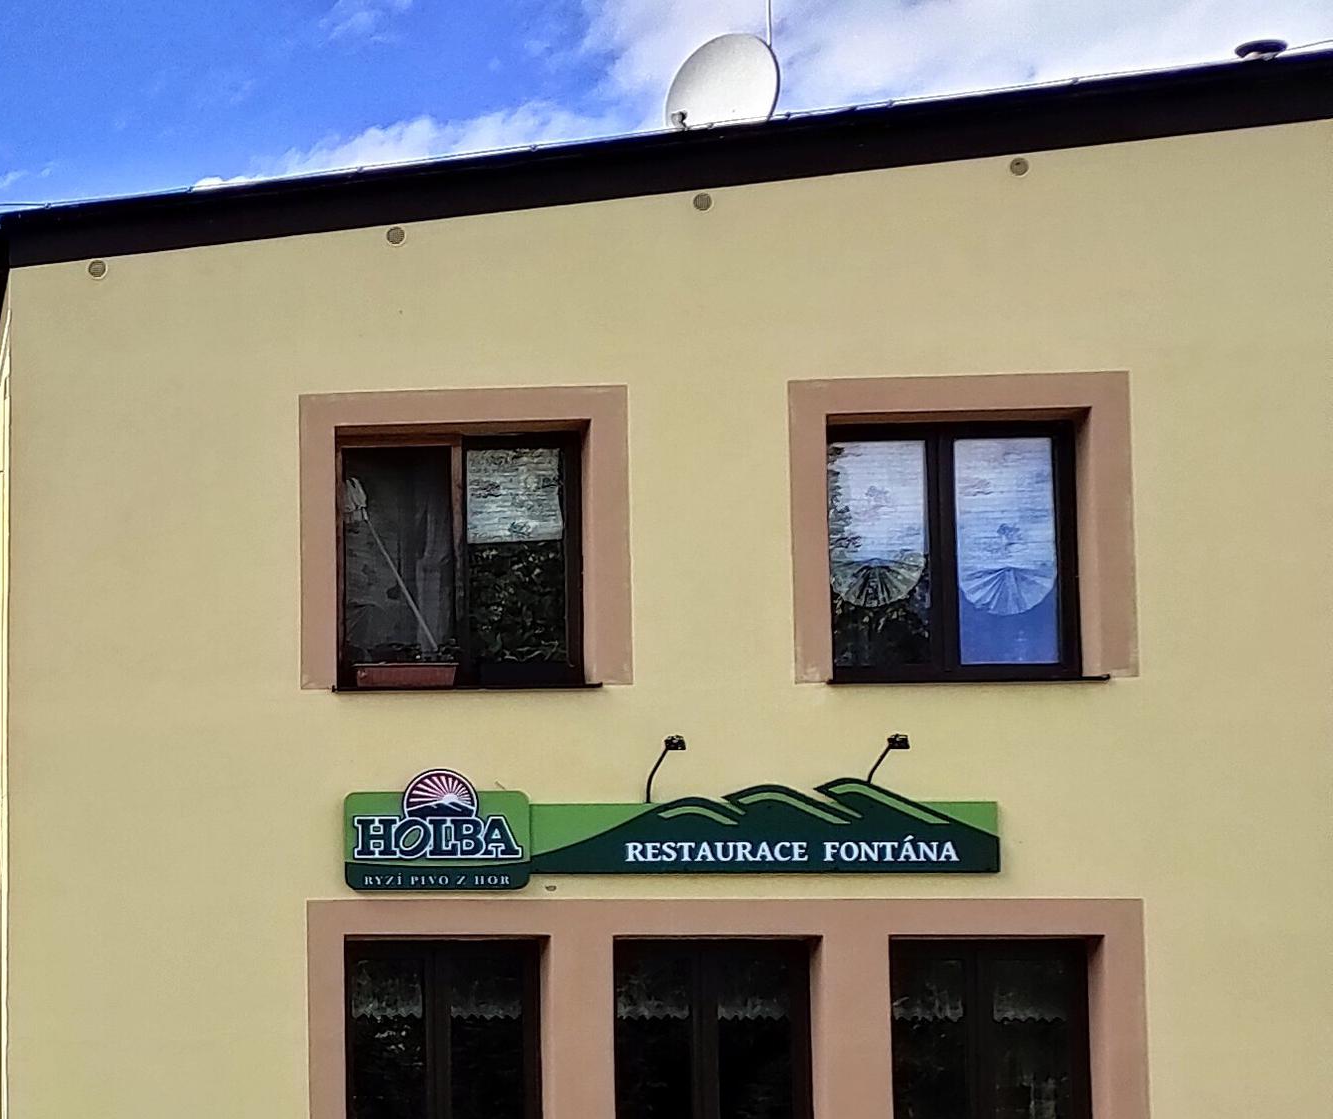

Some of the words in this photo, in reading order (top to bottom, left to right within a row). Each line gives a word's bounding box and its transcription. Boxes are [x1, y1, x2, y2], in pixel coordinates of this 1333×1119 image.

[353, 815, 524, 859] HOLBA
[625, 841, 808, 862] RESTAURACE
[823, 835, 960, 862] FONTÁNA
[364, 872, 402, 885] RYZÍ
[410, 875, 449, 885] PIVO
[456, 875, 467, 885] Z
[474, 875, 510, 885] HOR
